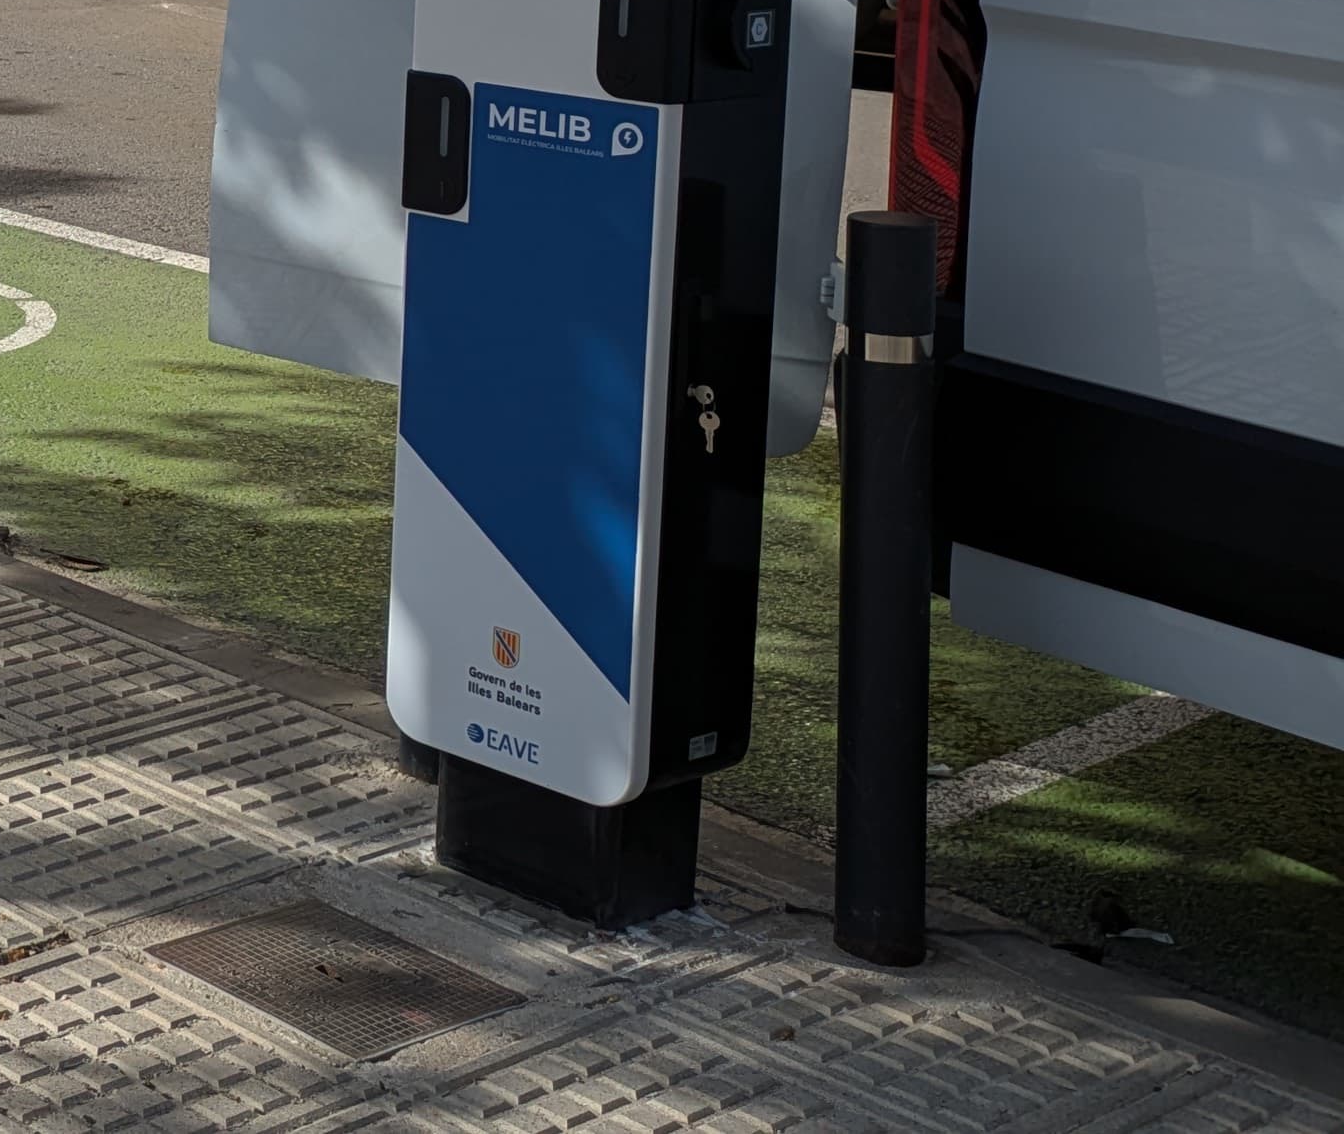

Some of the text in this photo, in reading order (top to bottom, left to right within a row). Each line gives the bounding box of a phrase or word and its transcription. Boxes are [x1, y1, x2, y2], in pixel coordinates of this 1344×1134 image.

[488, 103, 592, 143] MELIB
[487, 133, 520, 145] MOBILITAT
[555, 143, 574, 154] ILLES
[574, 147, 604, 158] BALEARS
[467, 681, 541, 715] Illes Balears
[468, 666, 542, 700] Govern de les
[486, 727, 540, 765] EAVE
